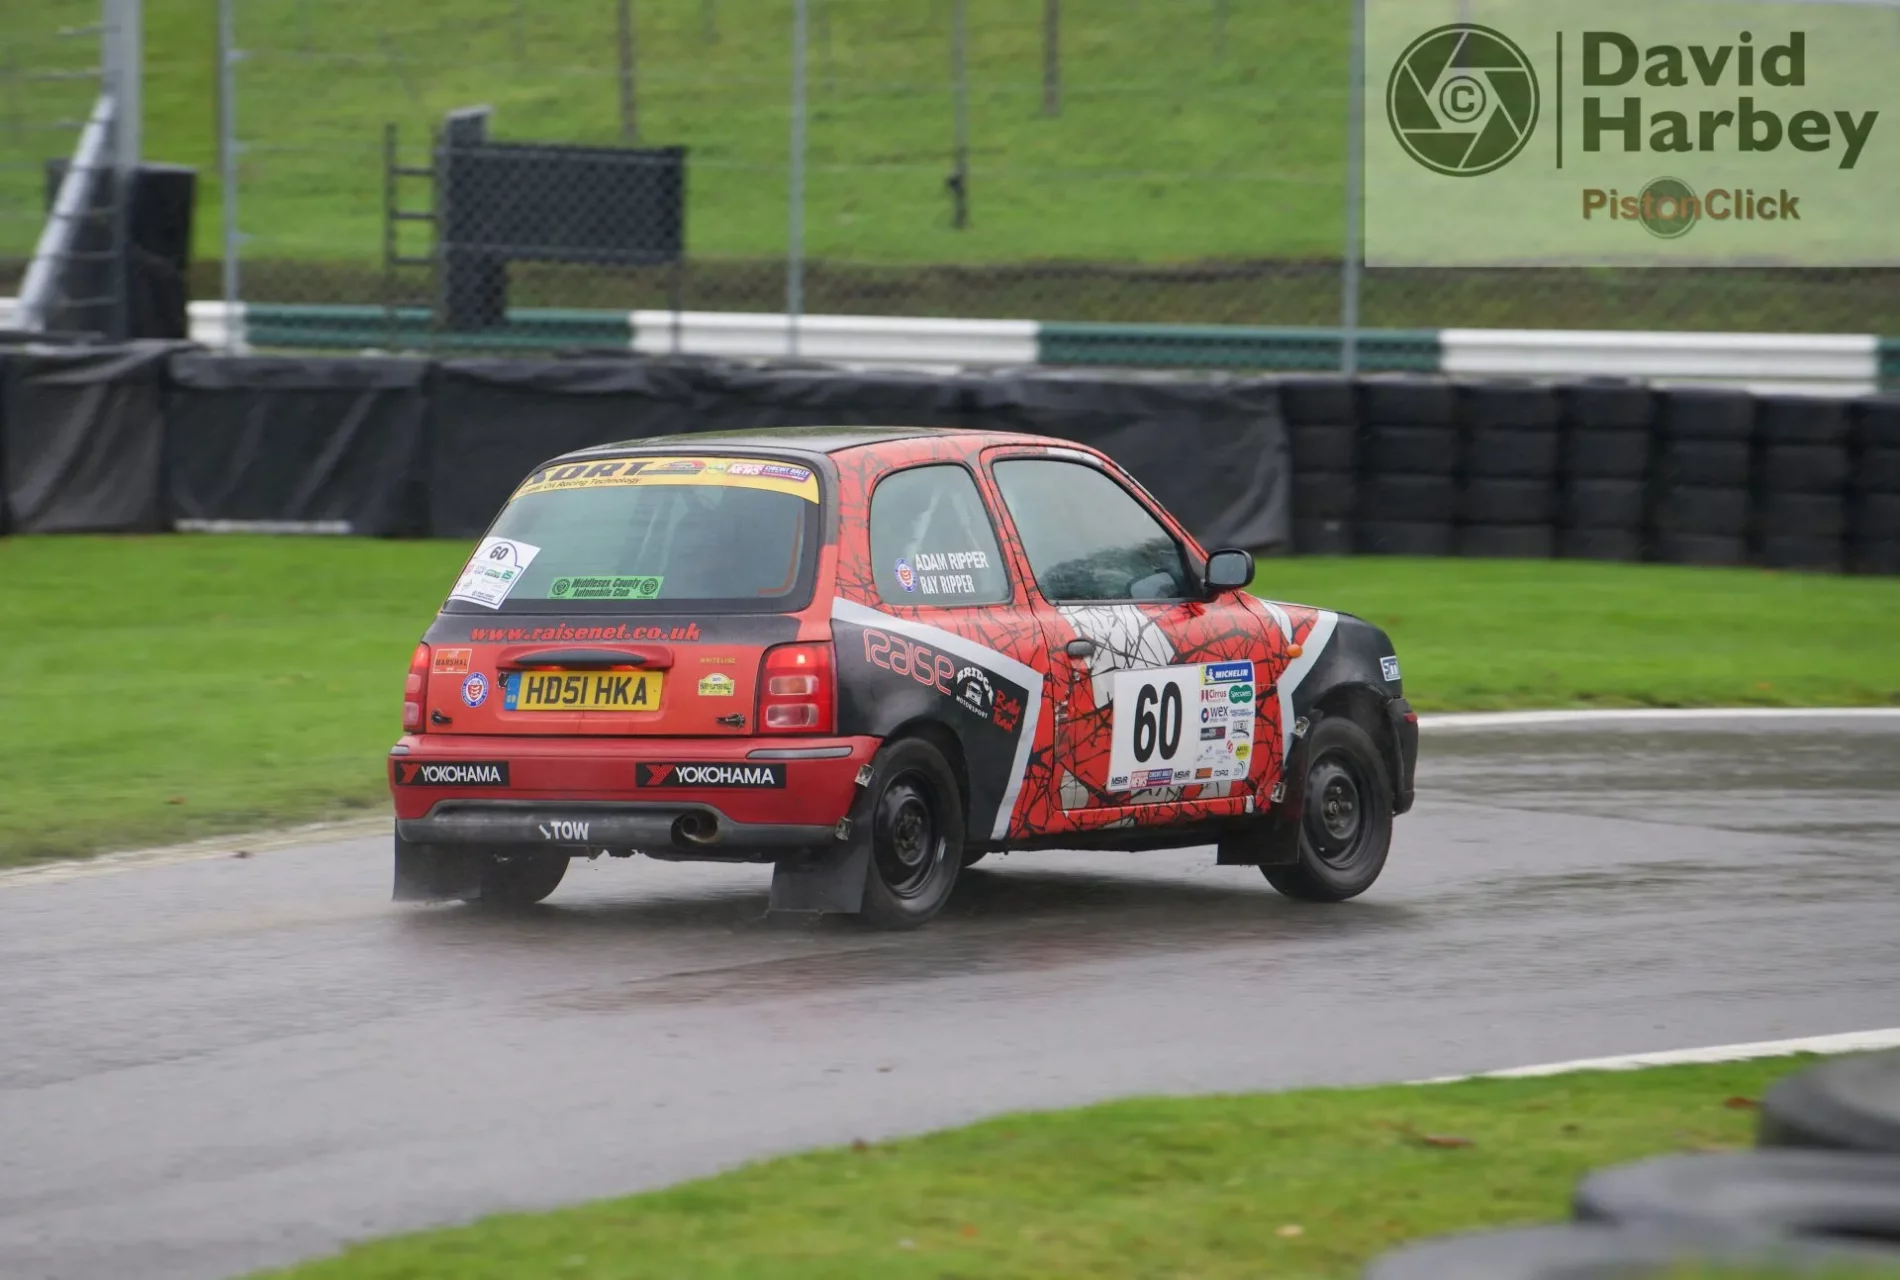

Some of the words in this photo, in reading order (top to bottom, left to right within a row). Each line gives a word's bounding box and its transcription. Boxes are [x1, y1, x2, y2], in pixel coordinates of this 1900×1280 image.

[557, 479, 588, 488] Racing
[590, 477, 642, 485] Technology
[489, 546, 509, 560] 60
[915, 553, 948, 571] ADAM
[949, 552, 989, 569] RIPPER
[571, 578, 612, 588] Middlesex
[612, 578, 642, 589] County
[920, 577, 939, 594] RAY
[939, 574, 975, 594] RIPPER
[573, 588, 612, 597] Automobile
[612, 588, 630, 597] Club
[471, 623, 701, 641] www.raisenet.co.uk
[435, 658, 467, 666] MARSHAL
[1215, 669, 1249, 679] MICHELIN
[525, 676, 588, 704] HD51
[595, 676, 648, 705] HKA
[1210, 690, 1226, 699] Cirrus
[956, 695, 988, 719] MOTORSPORT
[1210, 706, 1228, 717] wex
[1133, 681, 1182, 763] 60
[421, 766, 501, 782] YOKOHAMA
[676, 767, 775, 784] YOKOHAMA
[551, 820, 589, 841] TOW
